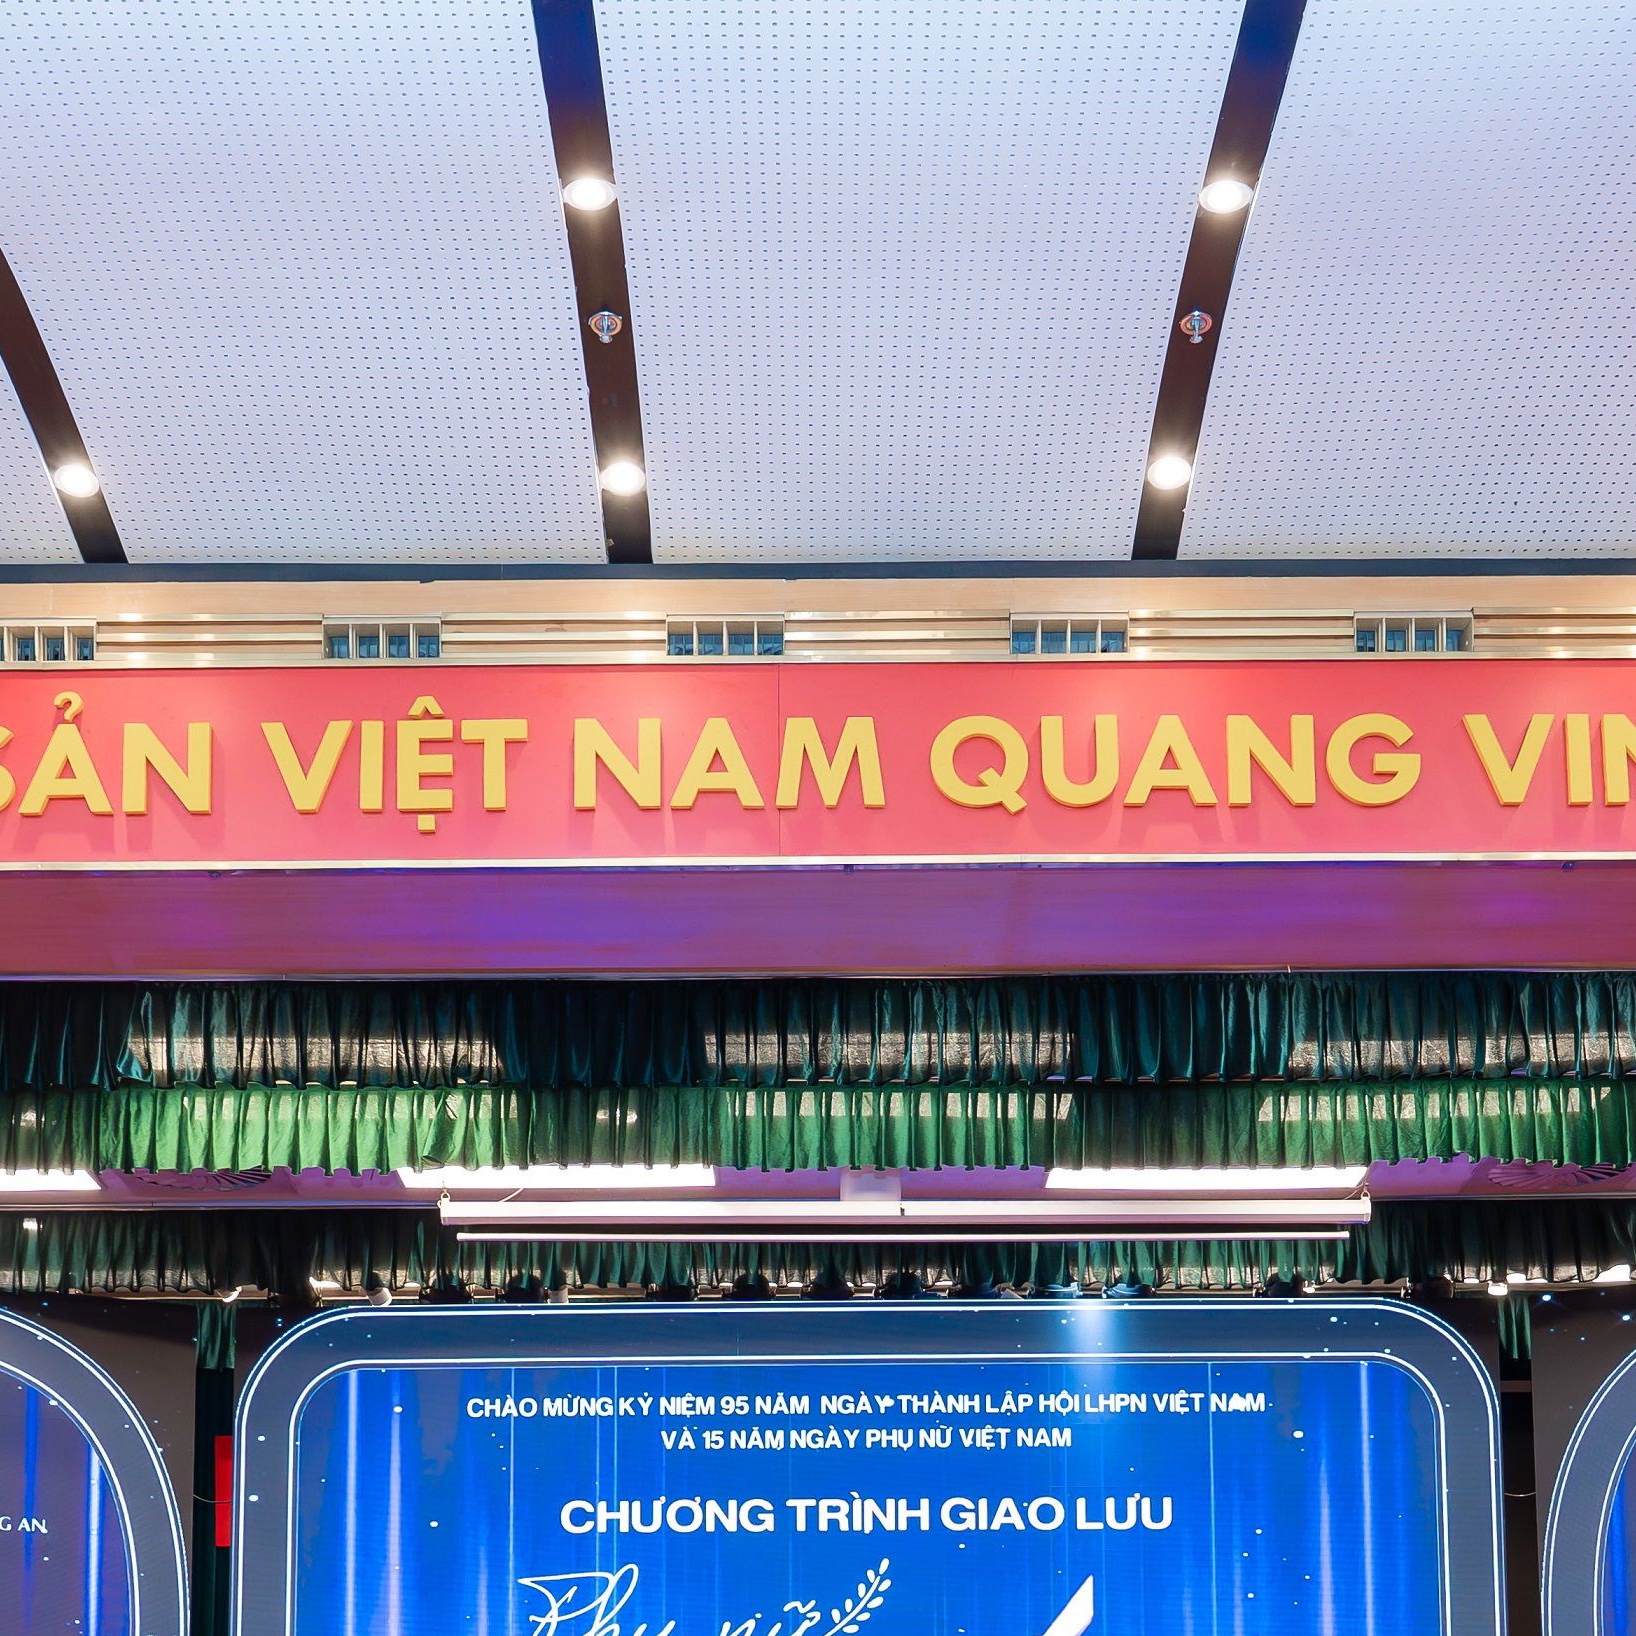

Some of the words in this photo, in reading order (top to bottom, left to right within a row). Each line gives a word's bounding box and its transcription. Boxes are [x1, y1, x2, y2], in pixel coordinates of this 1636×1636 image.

[260, 694, 529, 835] VIỆT
[573, 715, 886, 811] NAM
[928, 713, 1423, 813] QUANG
[466, 1394, 538, 1418] CHÀO
[543, 1393, 614, 1417] MỪNG
[618, 1391, 653, 1416] KỶ
[659, 1392, 715, 1418] NIỆM
[720, 1395, 749, 1416] 95
[755, 1392, 809, 1415] NĂM
[820, 1390, 892, 1415] NGÀY
[897, 1390, 980, 1414] THÀNH
[985, 1390, 1034, 1416] LẬP
[1039, 1390, 1080, 1416] HỘI
[1084, 1392, 1147, 1413] LHPN
[1152, 1389, 1205, 1415] VIỆT
[1210, 1391, 1266, 1412] NAM
[660, 1426, 696, 1450] VÀ
[702, 1430, 725, 1450] 15
[730, 1426, 784, 1450] NĂM
[789, 1426, 860, 1450] NGÀY
[865, 1427, 912, 1452] PHỤ
[919, 1424, 954, 1448] NỮ
[959, 1424, 1011, 1450] VIỆT
[1016, 1427, 1072, 1448] NAM
[17, 1516, 48, 1533] AN
[560, 1496, 775, 1534] CHƯƠNG
[785, 1491, 930, 1533] TRÌNH
[940, 1496, 1065, 1531] GIAO
[1076, 1492, 1173, 1531] LƯU
